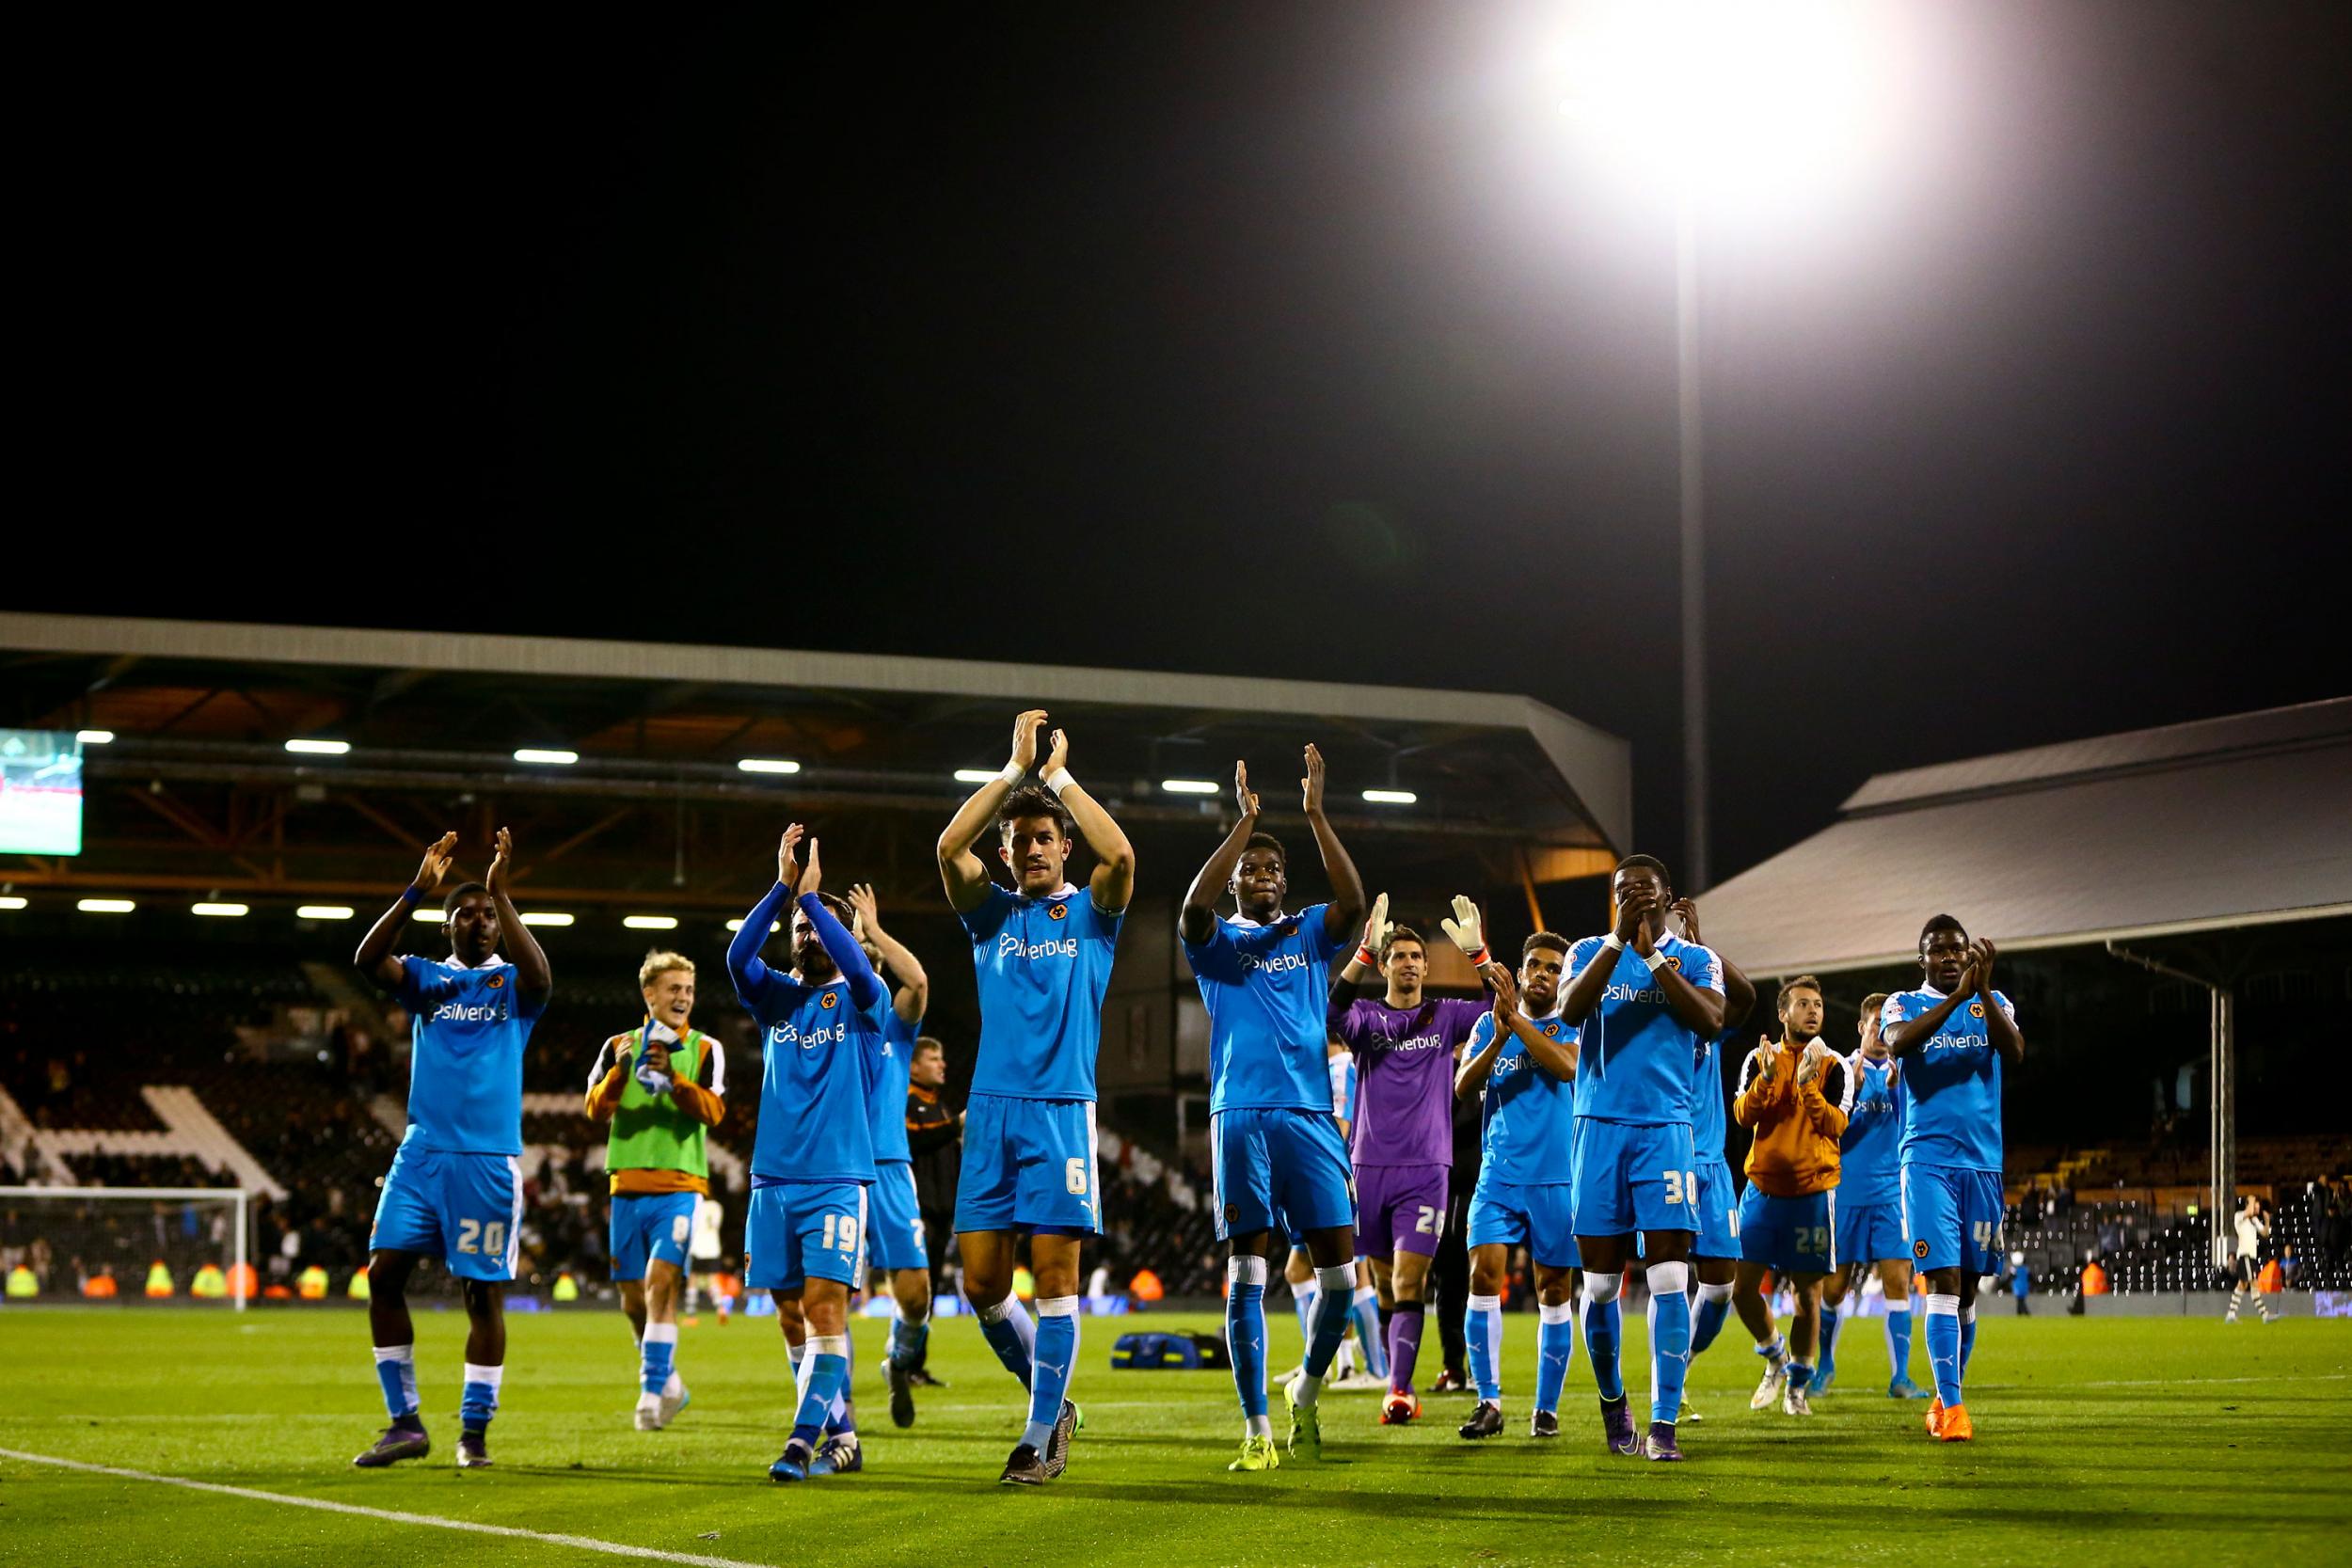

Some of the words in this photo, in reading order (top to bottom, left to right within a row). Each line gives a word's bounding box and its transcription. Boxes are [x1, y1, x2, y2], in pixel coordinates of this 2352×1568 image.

[1065, 1157, 1088, 1196] 6
[1662, 1170, 1697, 1205] 30
[456, 1217, 504, 1256] 20
[822, 1213, 857, 1253] 19
[1794, 1226, 1828, 1255] 29
